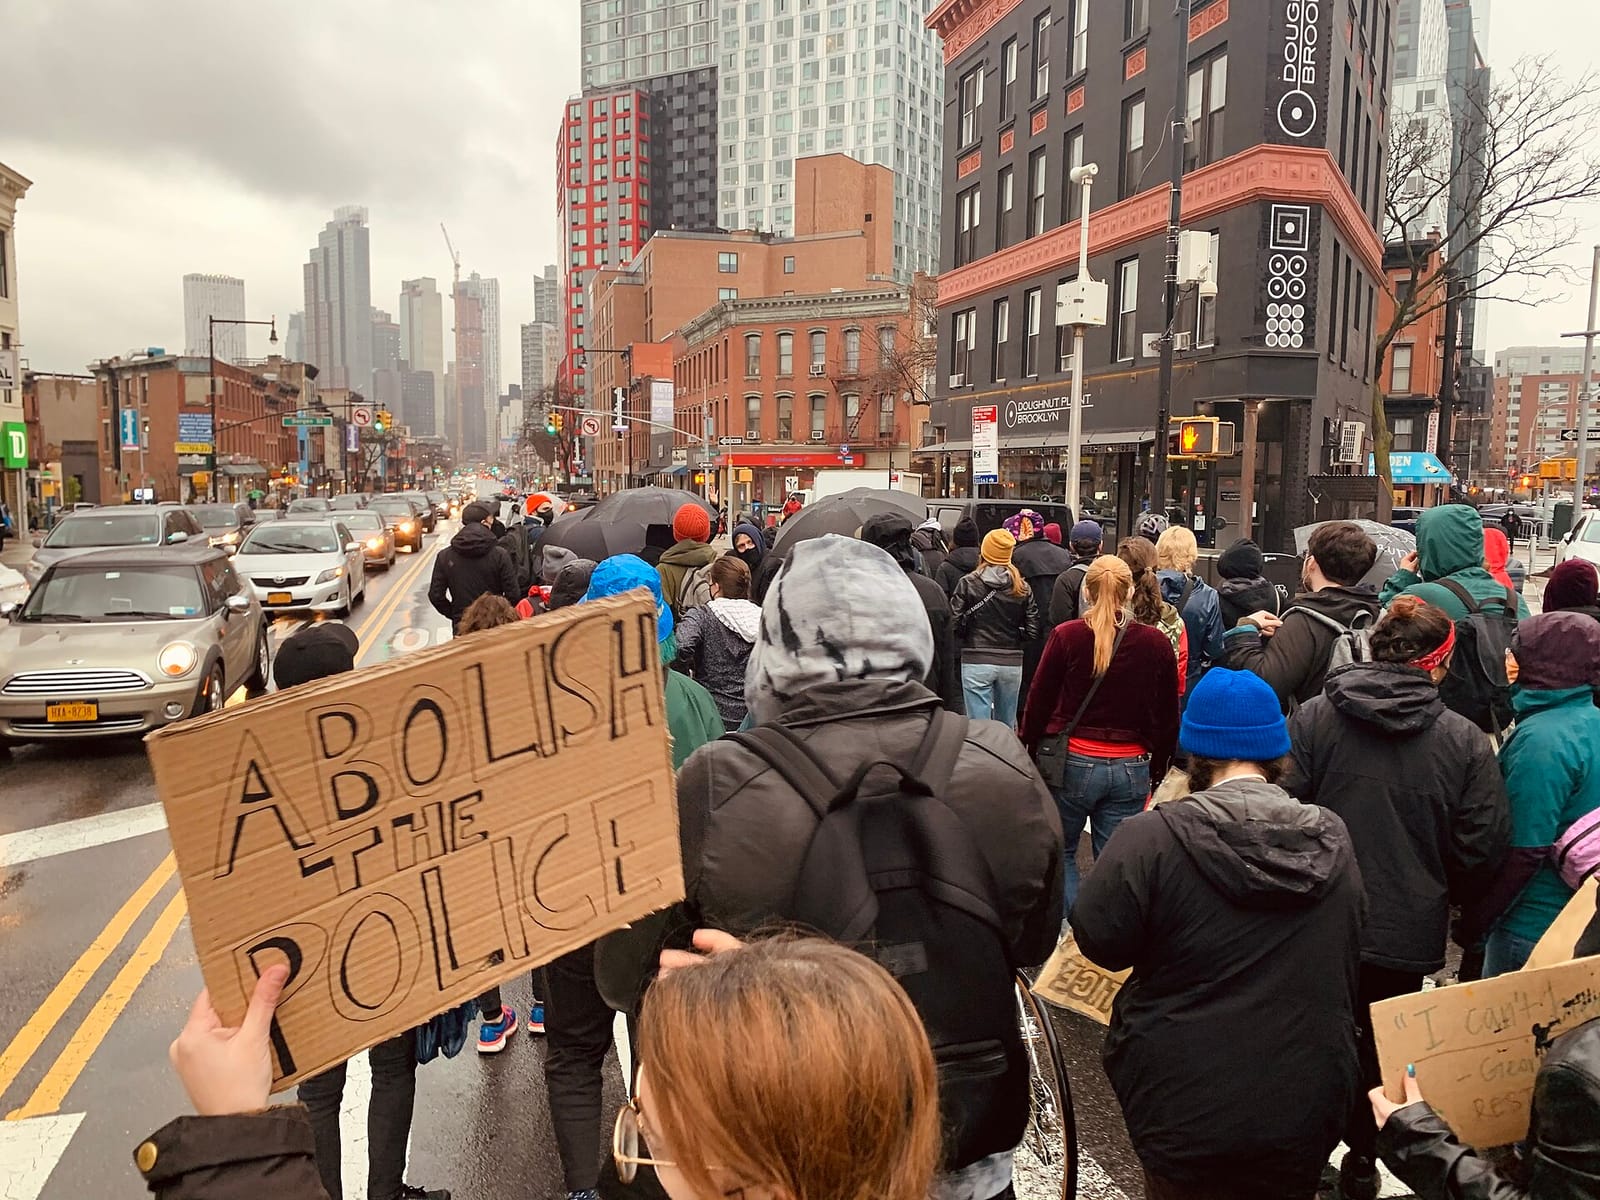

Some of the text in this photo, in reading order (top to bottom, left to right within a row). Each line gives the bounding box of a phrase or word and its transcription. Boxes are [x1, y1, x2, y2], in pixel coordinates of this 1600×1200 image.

[1283, 0, 1300, 82] DOUG
[1302, 0, 1319, 84] BROO
[1017, 411, 1059, 425] BROOKLYN
[1018, 394, 1092, 412] DOUGHNUT PLNT
[212, 611, 656, 880] ABOLISH
[298, 789, 490, 895] THE
[232, 779, 663, 1083] POLICE
